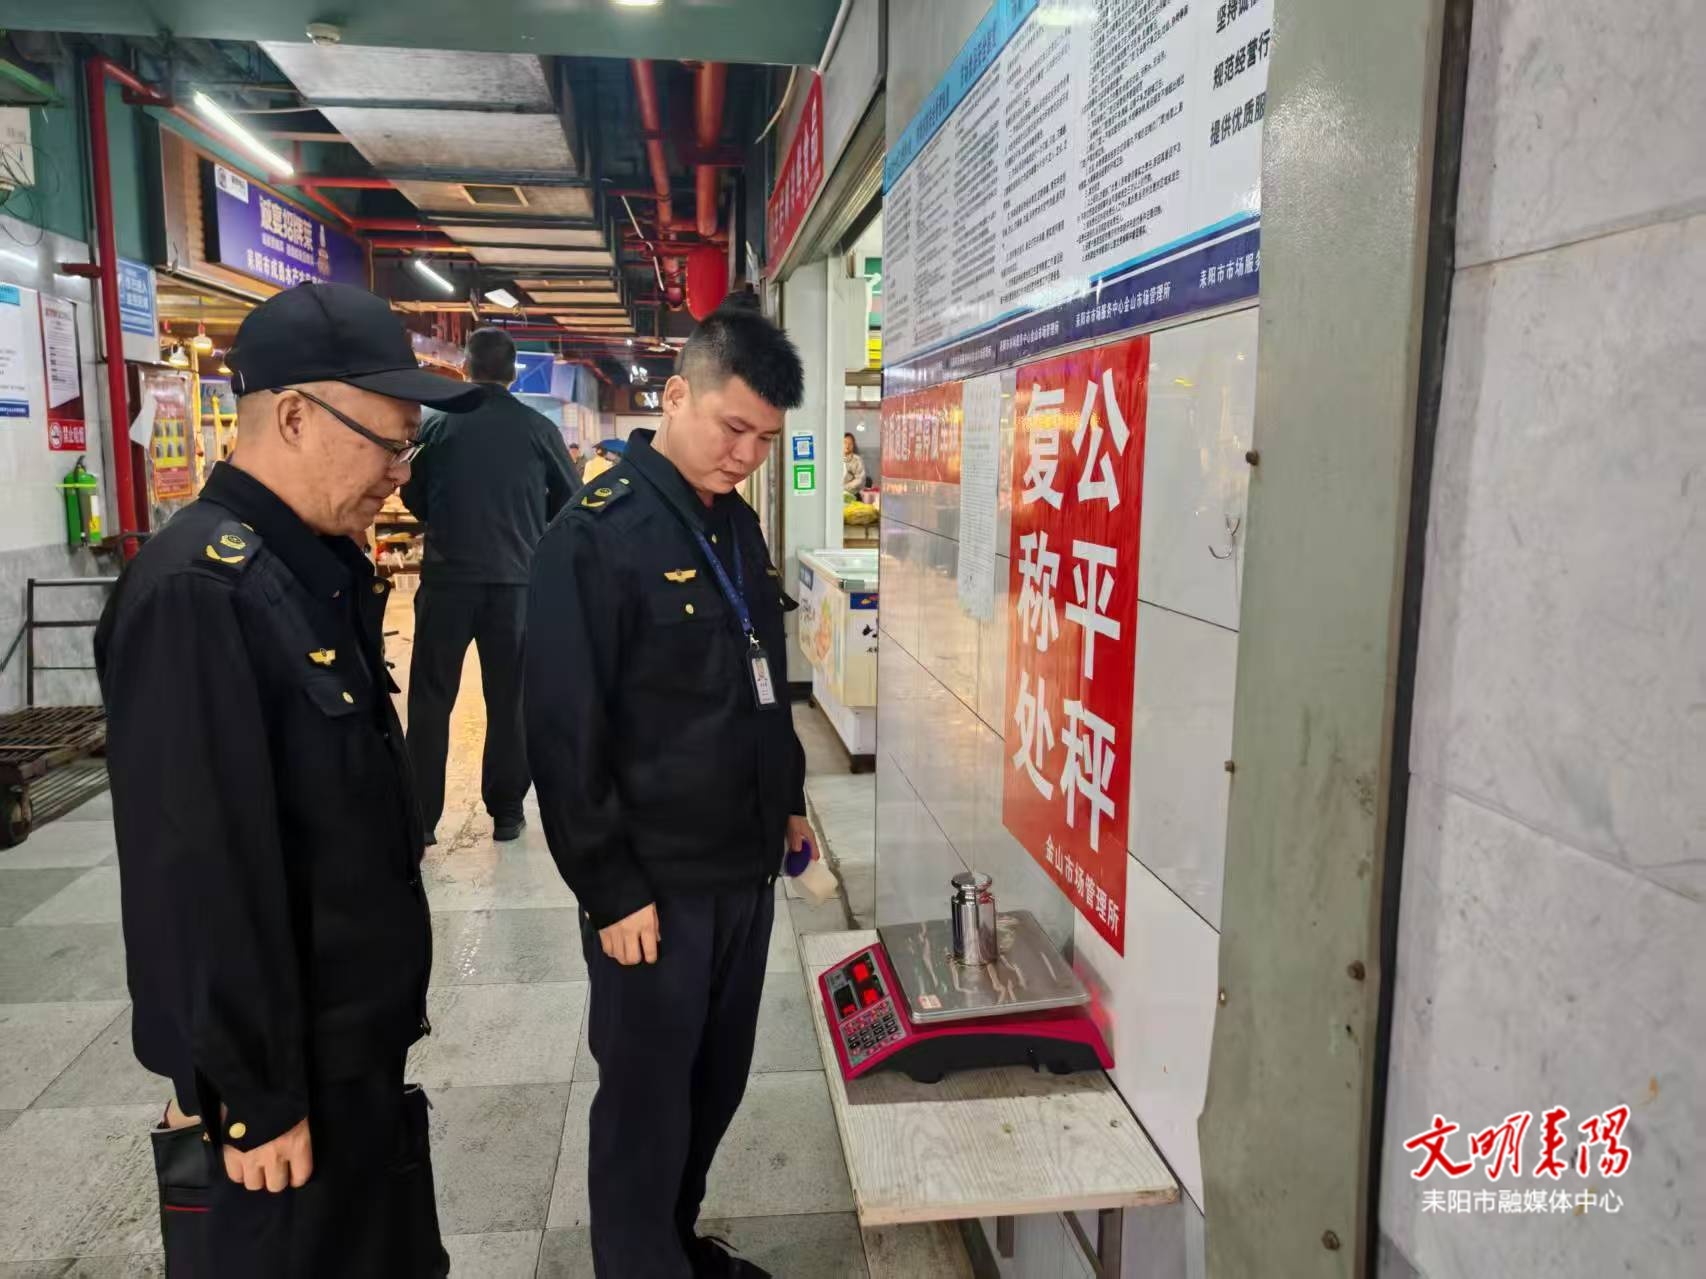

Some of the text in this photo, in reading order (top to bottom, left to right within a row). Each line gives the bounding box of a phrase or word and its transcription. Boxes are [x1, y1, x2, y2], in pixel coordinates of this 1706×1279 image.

[1213, 28, 1271, 91] 规范经营行
[1210, 92, 1266, 147] 提供优质服
[1075, 281, 1171, 327] 耒阳市市场服务中心金山市场管理所
[1013, 383, 1065, 800] 复称处
[1061, 367, 1130, 854] 公平秤
[1045, 833, 1120, 937] 金山市场管理所
